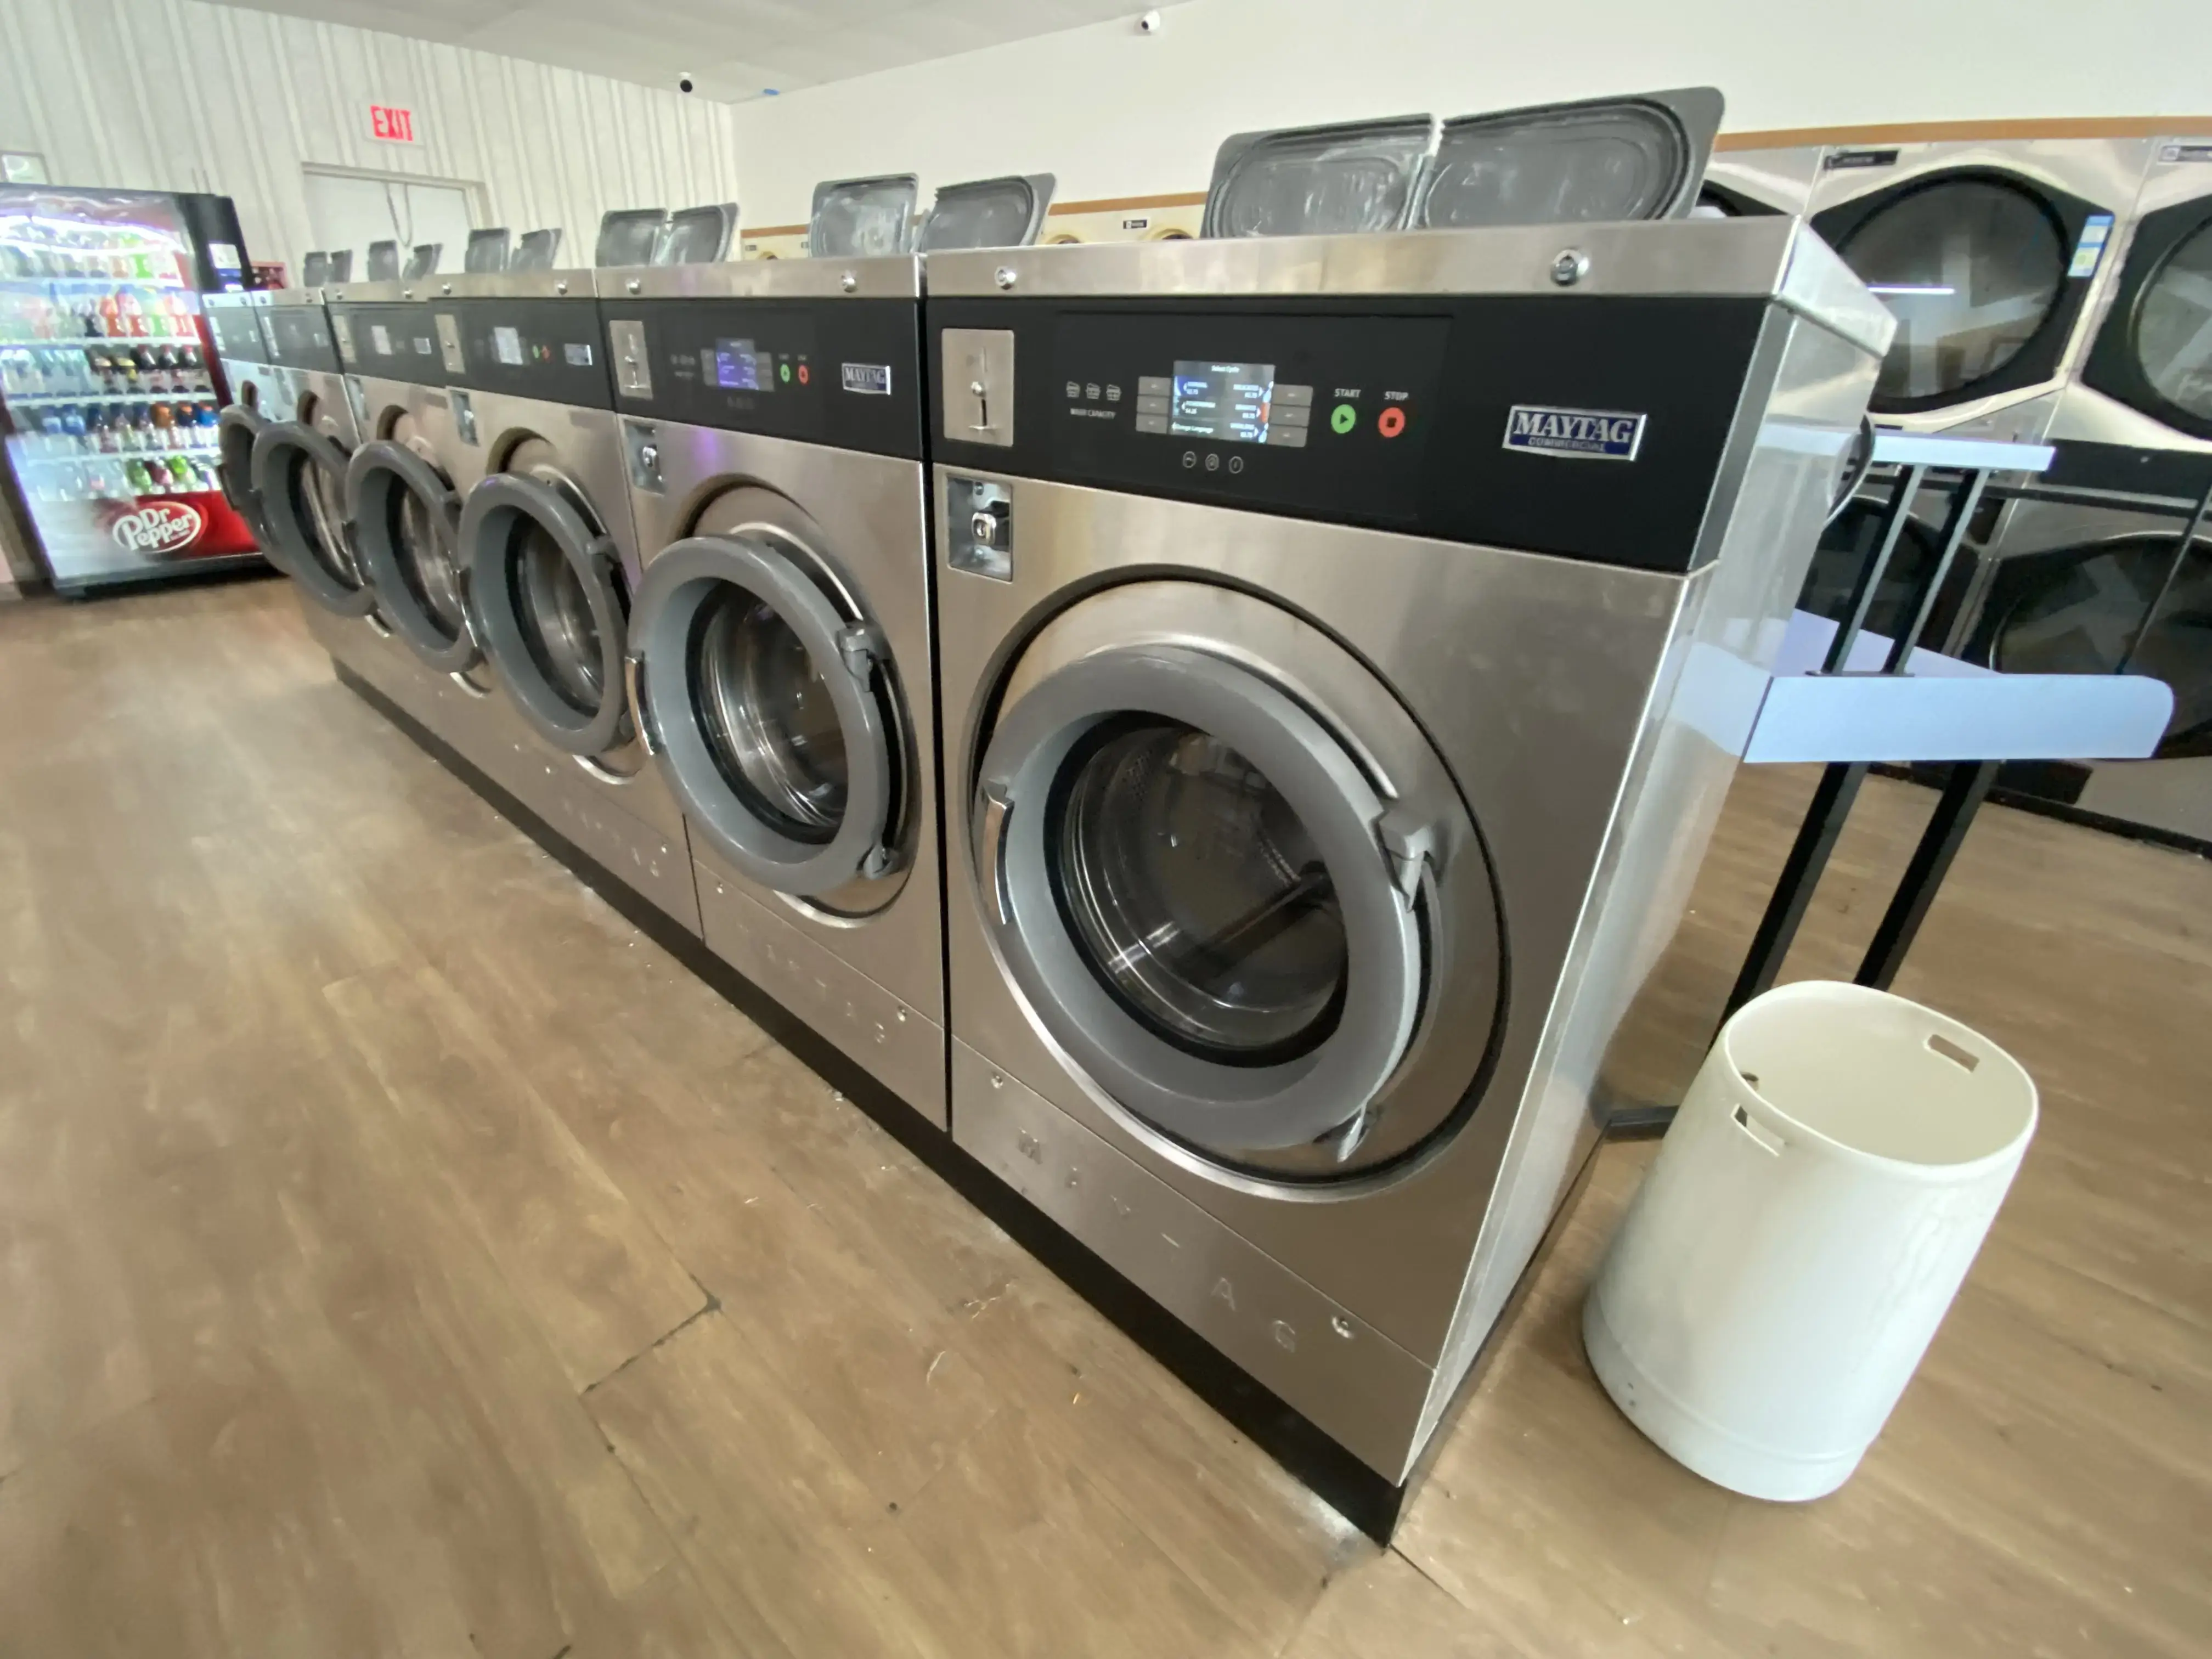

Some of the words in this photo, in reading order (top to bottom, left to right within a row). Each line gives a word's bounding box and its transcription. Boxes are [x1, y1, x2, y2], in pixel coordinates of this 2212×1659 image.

[370, 105, 413, 141] EXIT
[845, 367, 884, 383] MAYTAG
[1334, 388, 1361, 397] START
[1385, 391, 1409, 400] STOP
[1513, 413, 1633, 443] MAYTAG
[139, 508, 171, 531] Dr
[112, 515, 192, 551] Pepper
